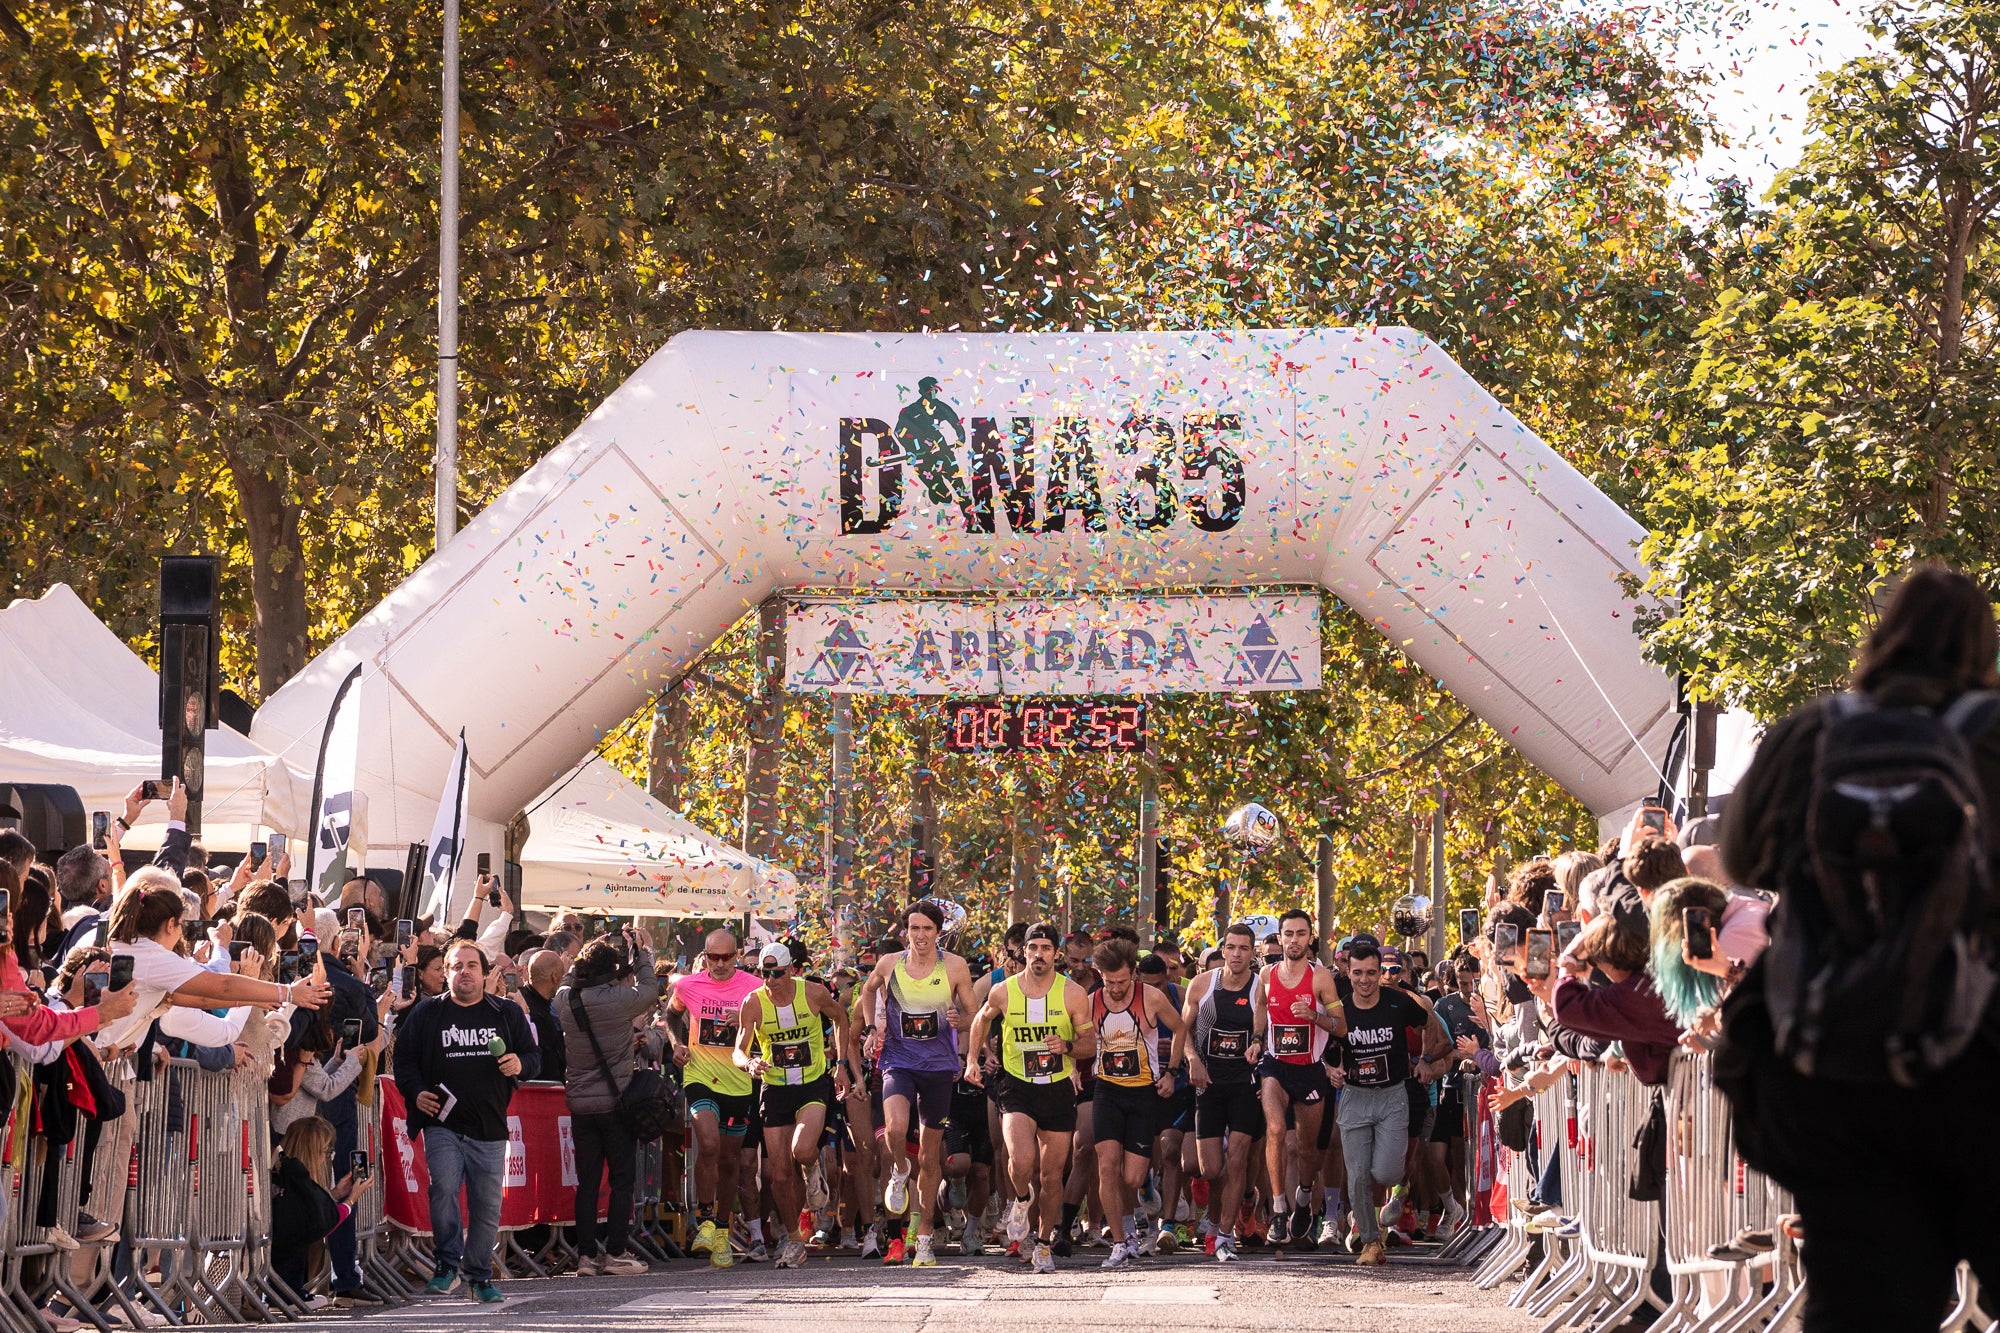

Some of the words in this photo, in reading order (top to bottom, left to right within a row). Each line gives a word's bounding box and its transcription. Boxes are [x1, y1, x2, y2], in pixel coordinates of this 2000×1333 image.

[910, 628, 1198, 672] ARRIBADA
[701, 1006, 722, 1014] RUN
[1281, 1036, 1298, 1045] 696
[1359, 1067, 1376, 1075] 885
